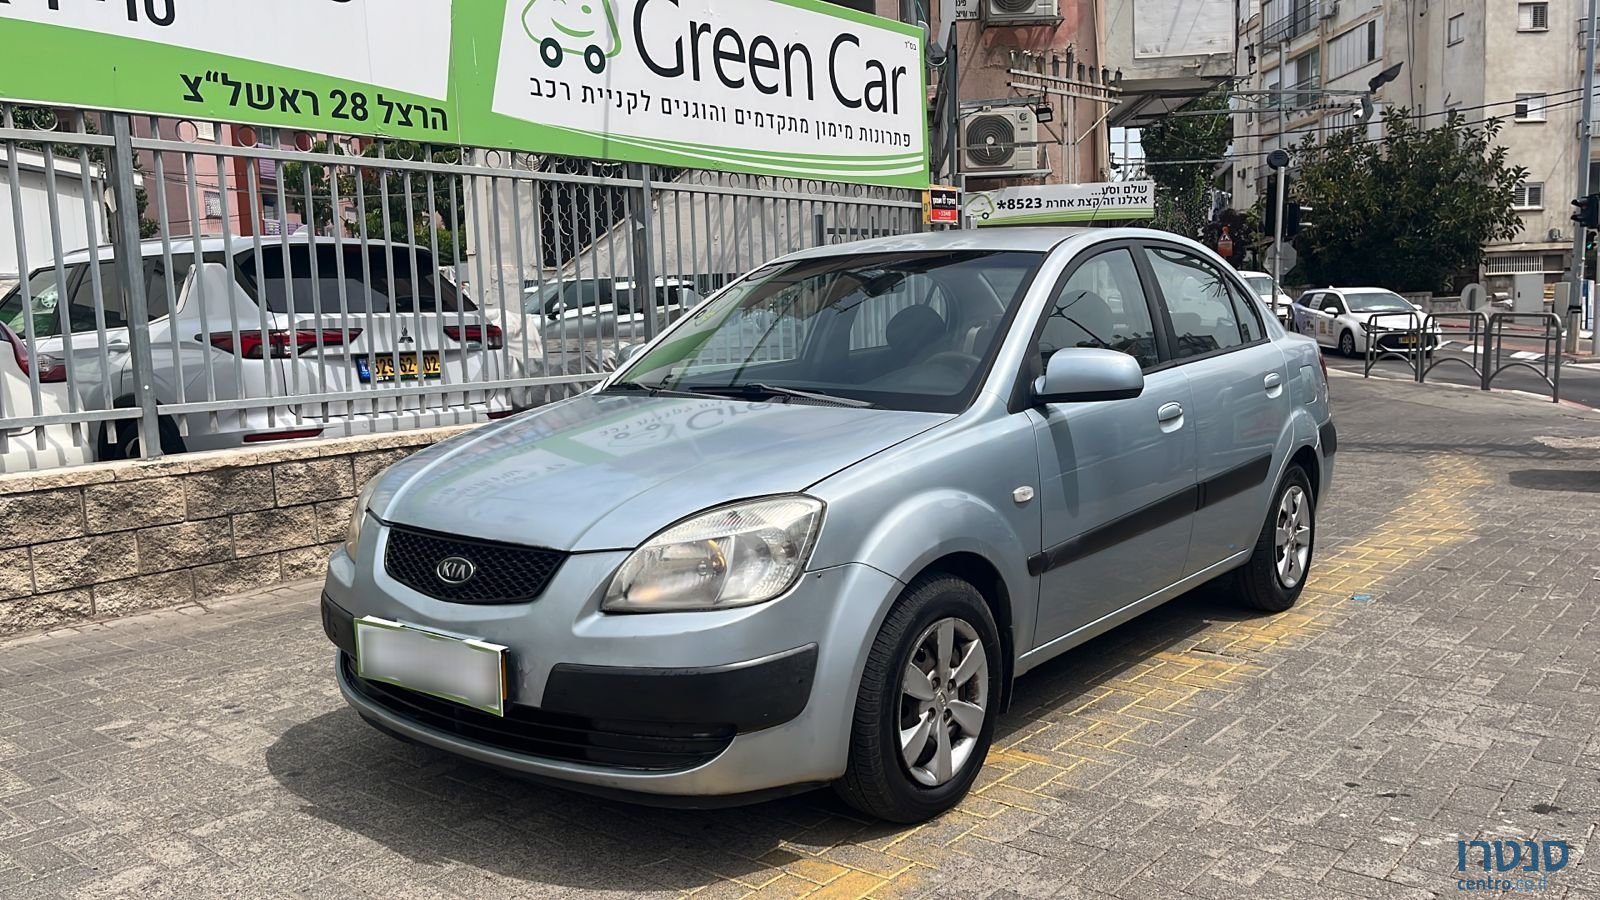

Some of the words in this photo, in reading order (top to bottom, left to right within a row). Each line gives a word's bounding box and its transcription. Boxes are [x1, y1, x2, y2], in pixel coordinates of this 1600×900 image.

[633, 0, 814, 101] Green
[829, 33, 907, 115] Car
[530, 77, 571, 101] רכב
[329, 89, 369, 122] 28
[582, 86, 651, 115] לקניית
[661, 97, 726, 123] והוגנים
[375, 93, 448, 132] הרצל
[735, 109, 809, 135] מתקדמים
[815, 120, 853, 140] מימון
[859, 127, 911, 148] פתרונות
[1124, 183, 1147, 194] שלם
[1046, 199, 1074, 208] אחרת
[1077, 197, 1100, 208] קצת
[1103, 197, 1115, 206] זה
[1118, 195, 1147, 205] אצלנו
[441, 561, 466, 580] KIA
